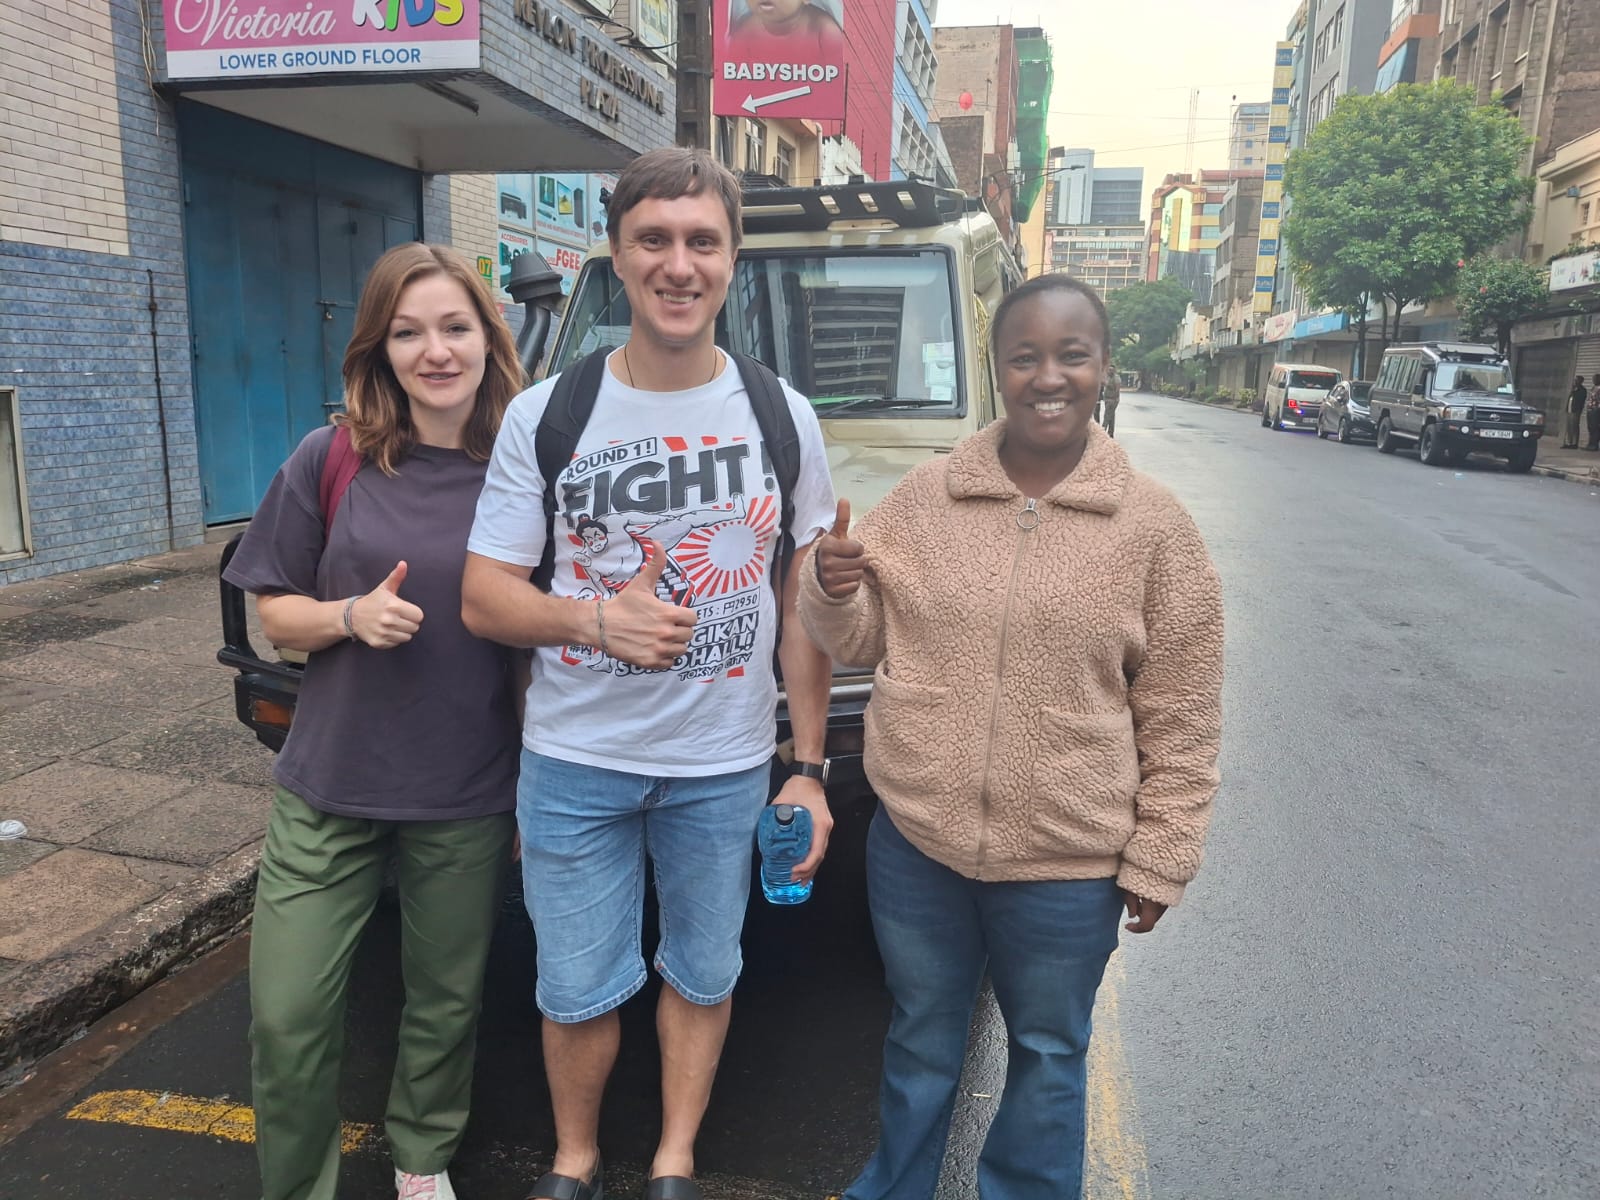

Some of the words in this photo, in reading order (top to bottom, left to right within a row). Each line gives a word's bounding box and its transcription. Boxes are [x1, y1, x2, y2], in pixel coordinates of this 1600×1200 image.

[175, 0, 336, 46] Victoria
[352, 0, 464, 31] KIDS
[220, 54, 277, 70] LOWER
[282, 50, 357, 67] GROUND
[363, 48, 421, 64] FLOOR
[723, 62, 839, 82] BABYSHOP
[479, 259, 492, 276] 07
[566, 448, 628, 481] ROUND
[688, 611, 759, 648] GIKAN
[615, 652, 690, 677] SUO
[679, 663, 723, 681] TOKYO
[724, 652, 753, 669] CITY
